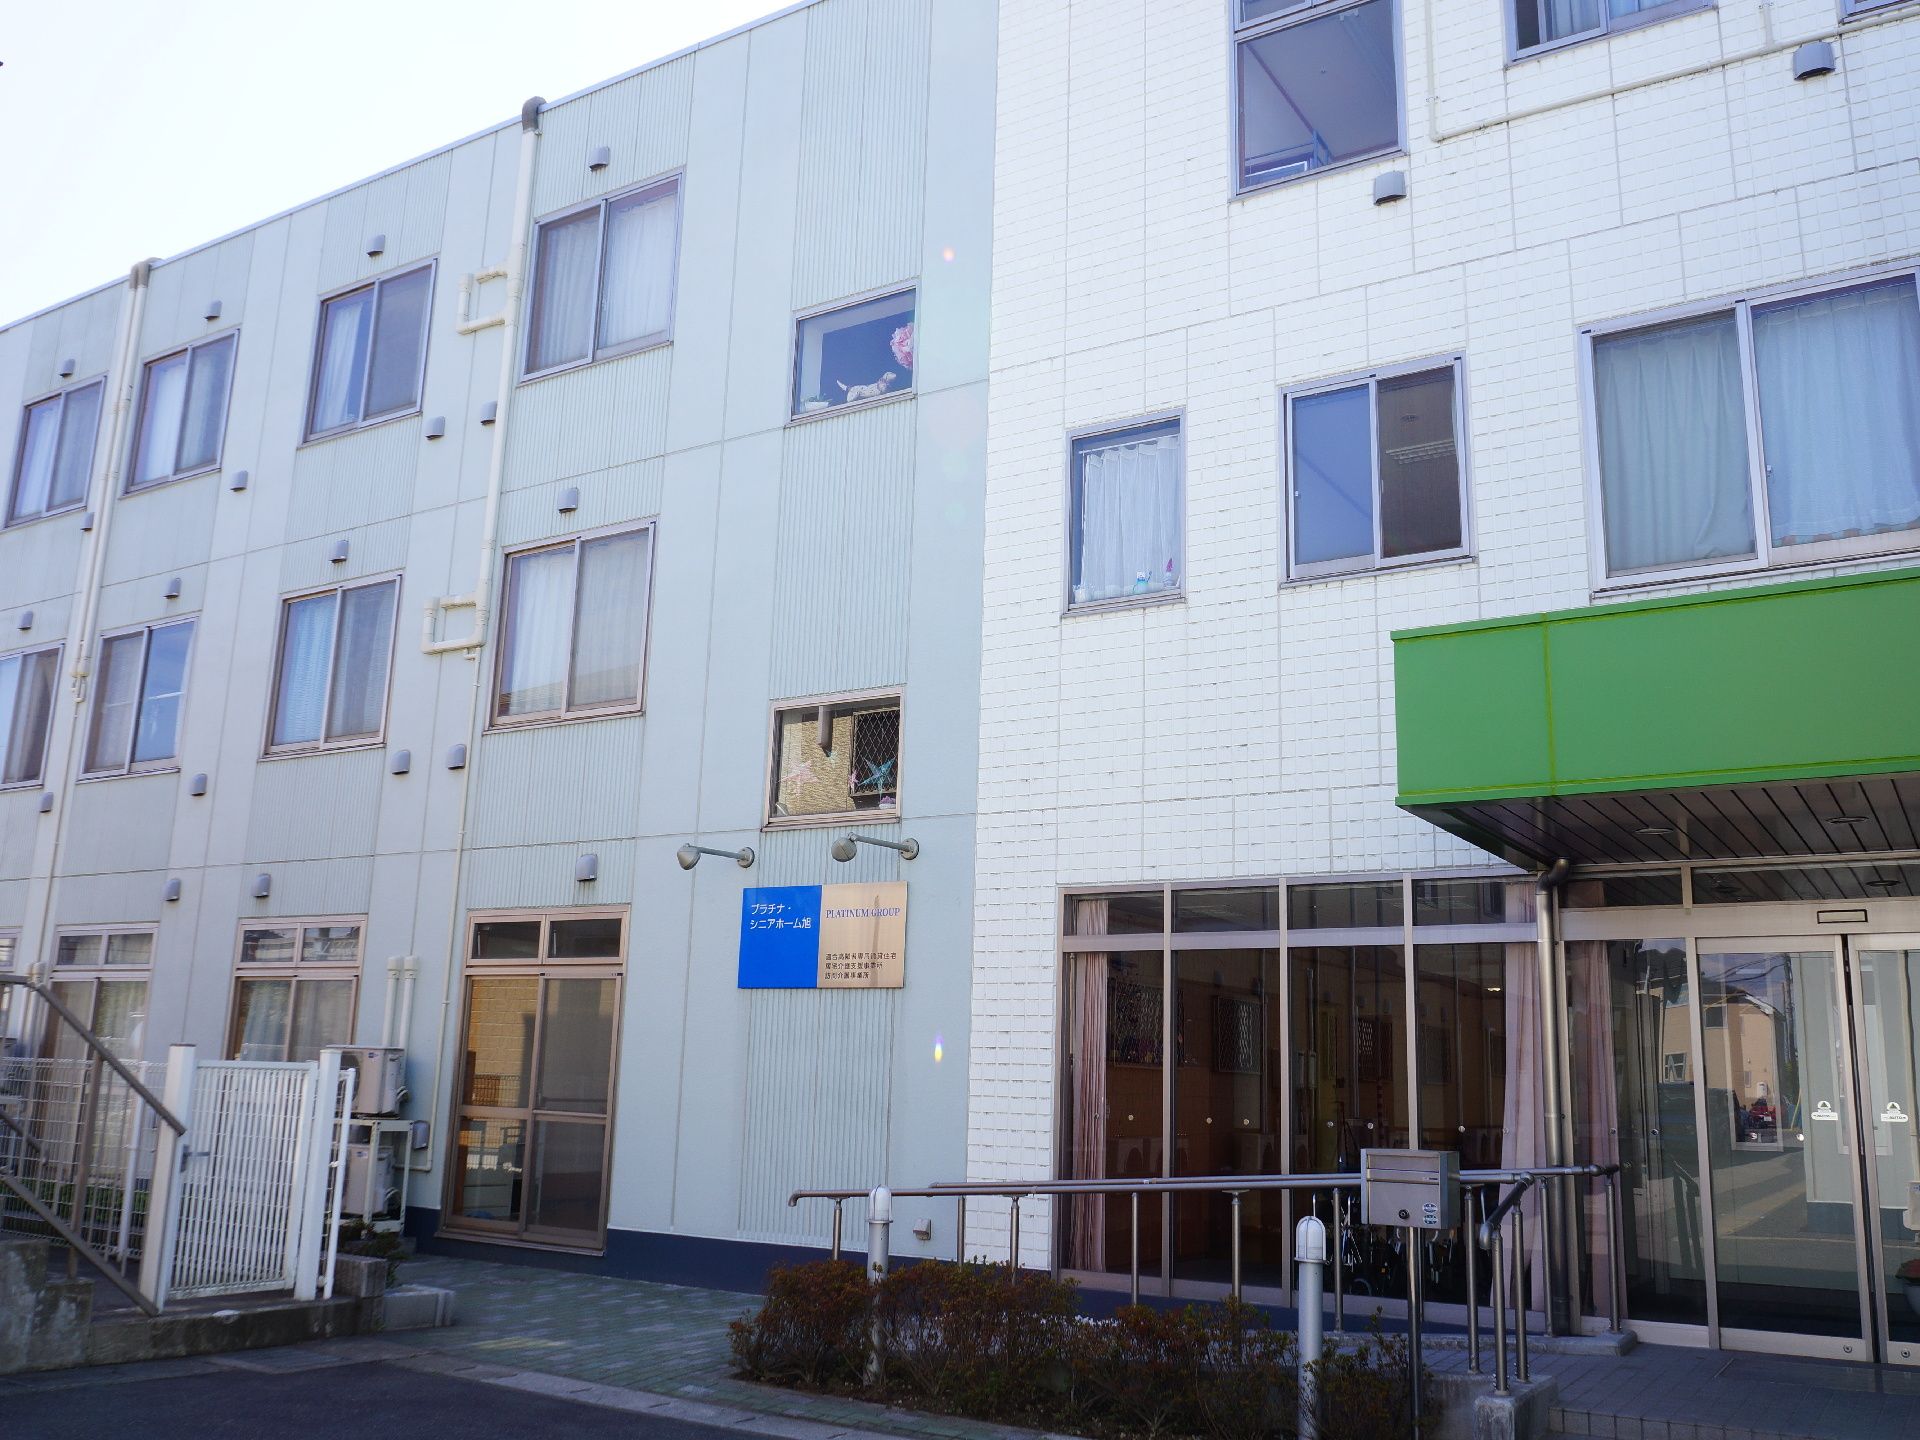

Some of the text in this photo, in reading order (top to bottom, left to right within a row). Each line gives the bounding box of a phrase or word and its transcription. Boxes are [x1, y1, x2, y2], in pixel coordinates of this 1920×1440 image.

[826, 907, 901, 919] PLATINUM GROUP
[750, 917, 812, 930] シニアホーム旭
